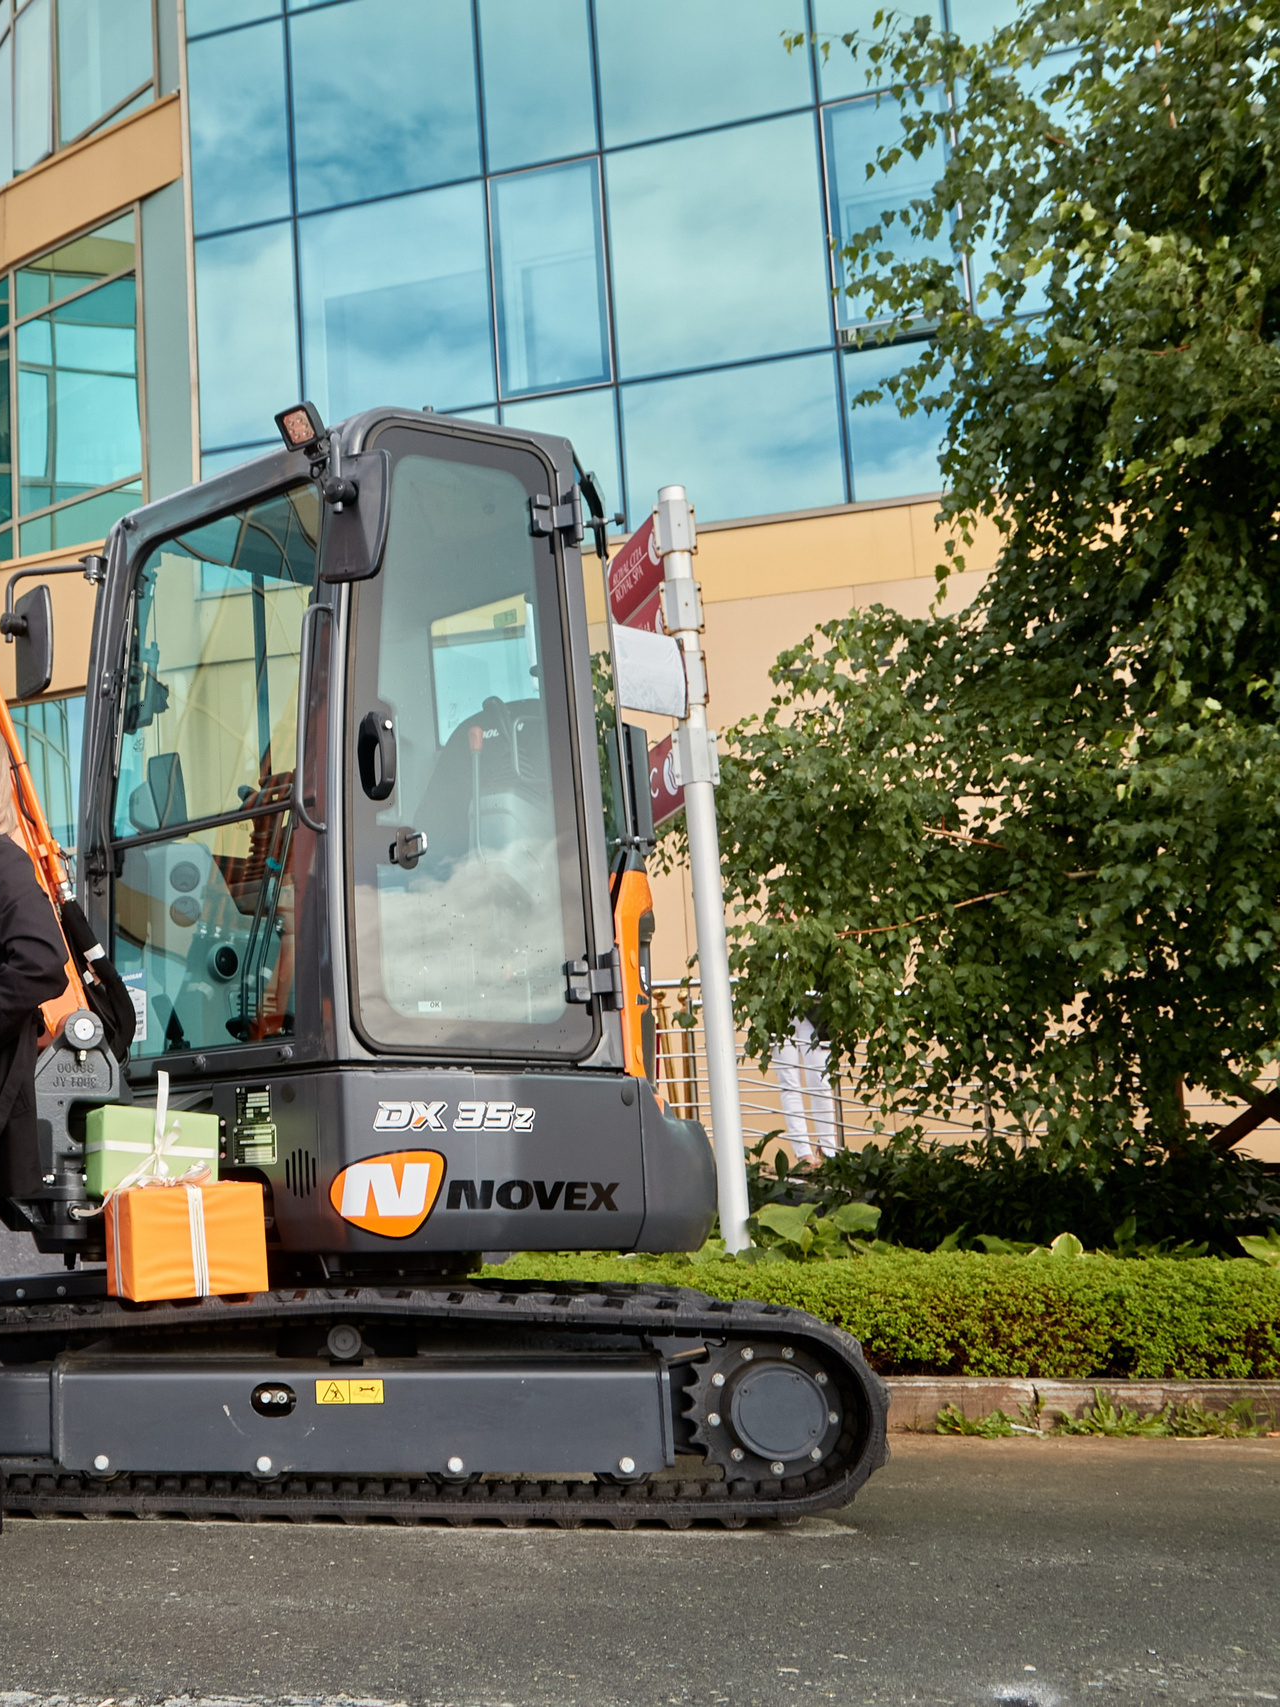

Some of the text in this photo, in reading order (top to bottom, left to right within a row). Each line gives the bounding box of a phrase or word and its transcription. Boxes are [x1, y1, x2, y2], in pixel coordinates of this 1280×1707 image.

[612, 559, 629, 587] ROYAL
[615, 564, 644, 603] ROYAL SPA
[373, 1101, 448, 1132] DX
[341, 1163, 430, 1217] N
[446, 1180, 620, 1211] NOVEX
